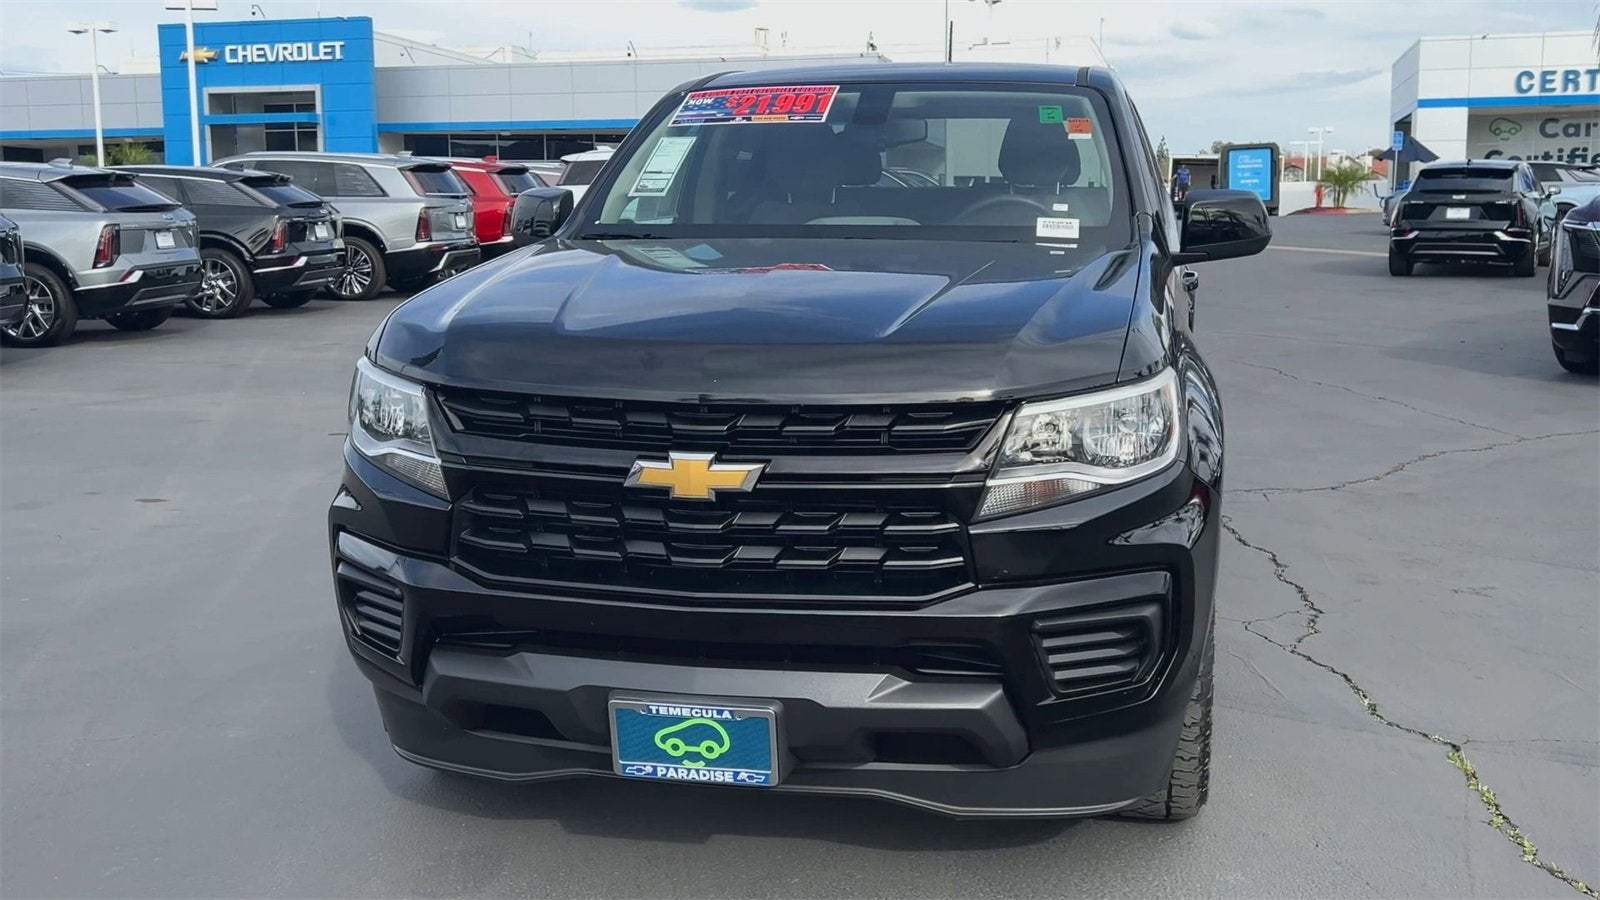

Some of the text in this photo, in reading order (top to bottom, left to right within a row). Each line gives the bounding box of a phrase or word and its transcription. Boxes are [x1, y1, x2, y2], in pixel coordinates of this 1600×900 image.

[225, 41, 344, 64] CHEVROLET
[1515, 70, 1600, 93] CERT
[688, 98, 714, 106] NOW
[1539, 118, 1599, 139] Car
[649, 705, 732, 719] TEMECULA
[656, 766, 735, 782] PARADISE
